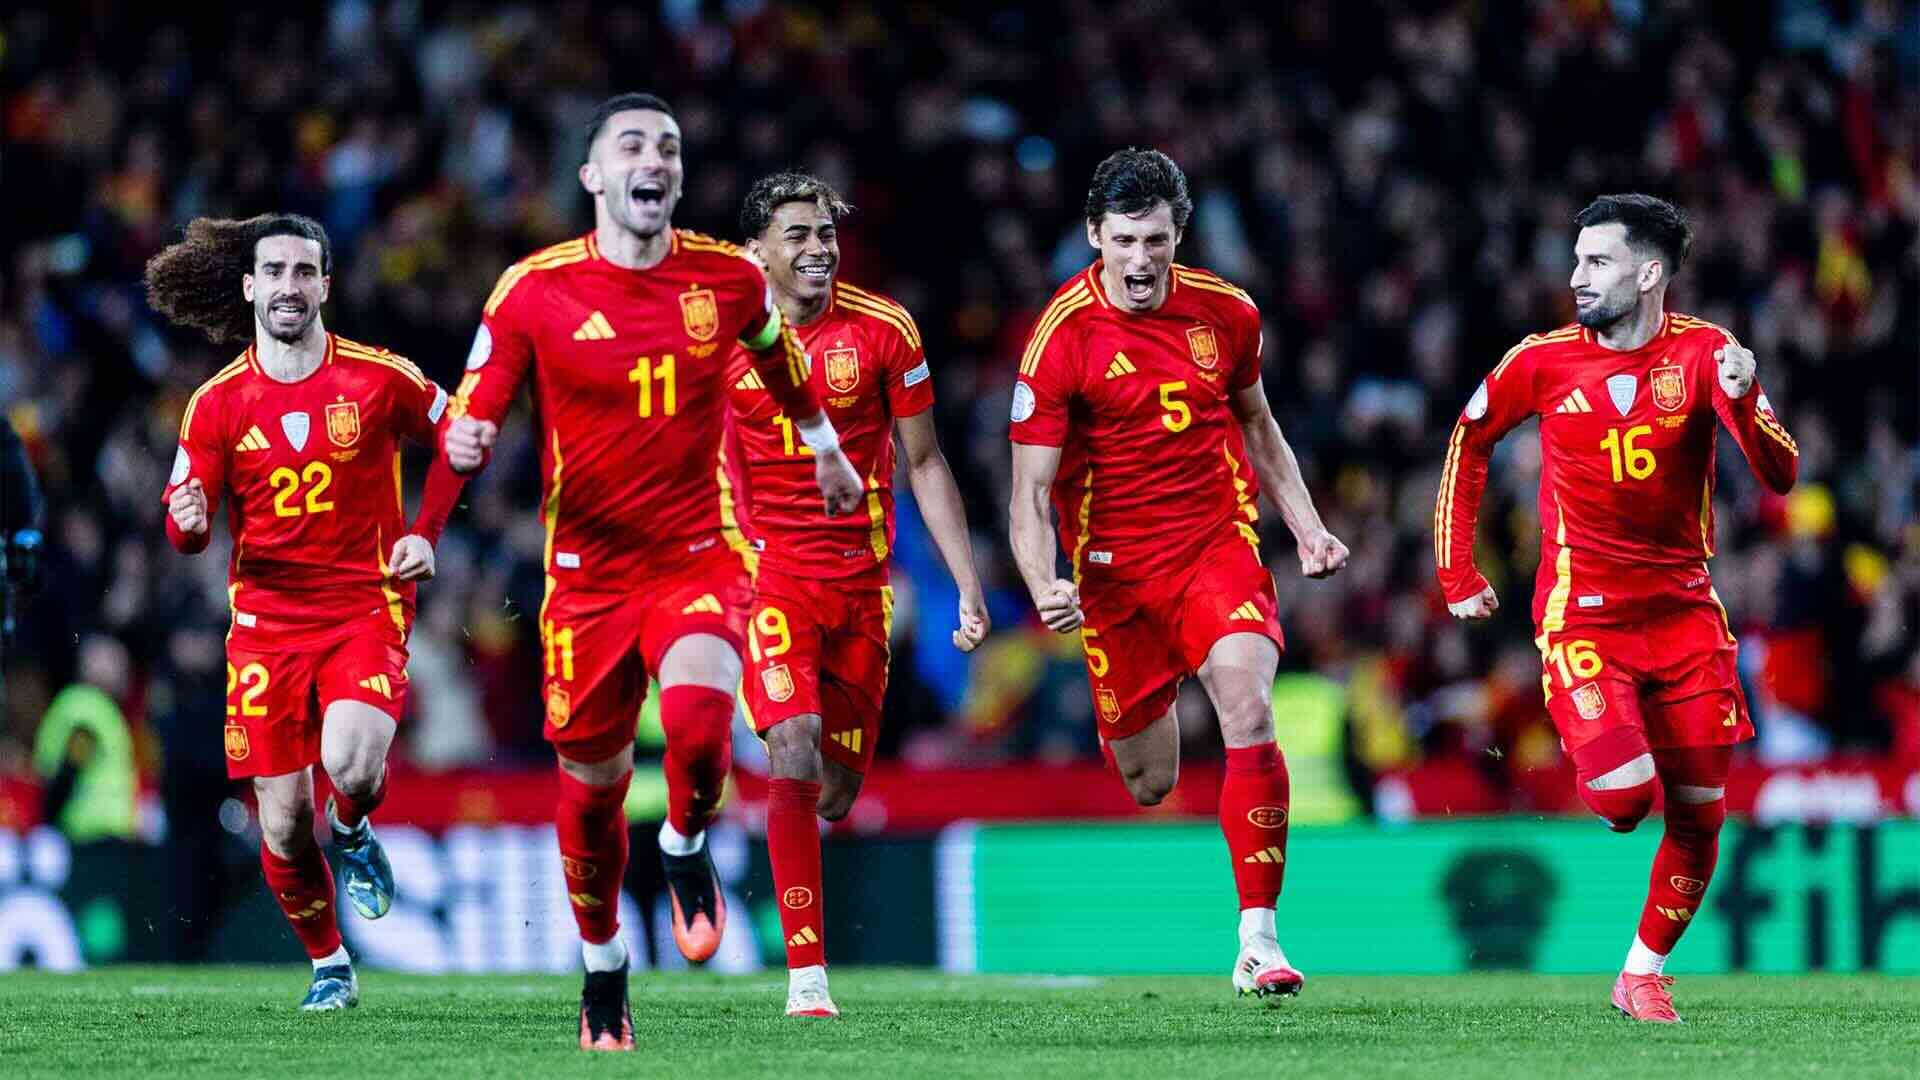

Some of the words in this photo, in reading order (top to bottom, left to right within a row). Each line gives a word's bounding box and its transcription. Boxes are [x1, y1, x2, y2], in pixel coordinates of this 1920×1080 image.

[628, 354, 676, 418] 11
[1159, 380, 1192, 434] 5
[772, 413, 817, 457] 1
[1599, 425, 1658, 482] 16
[269, 461, 335, 518] 22
[545, 619, 574, 681] 11
[747, 607, 792, 663] 19
[1080, 627, 1109, 678] 5
[1548, 639, 1603, 689] 16
